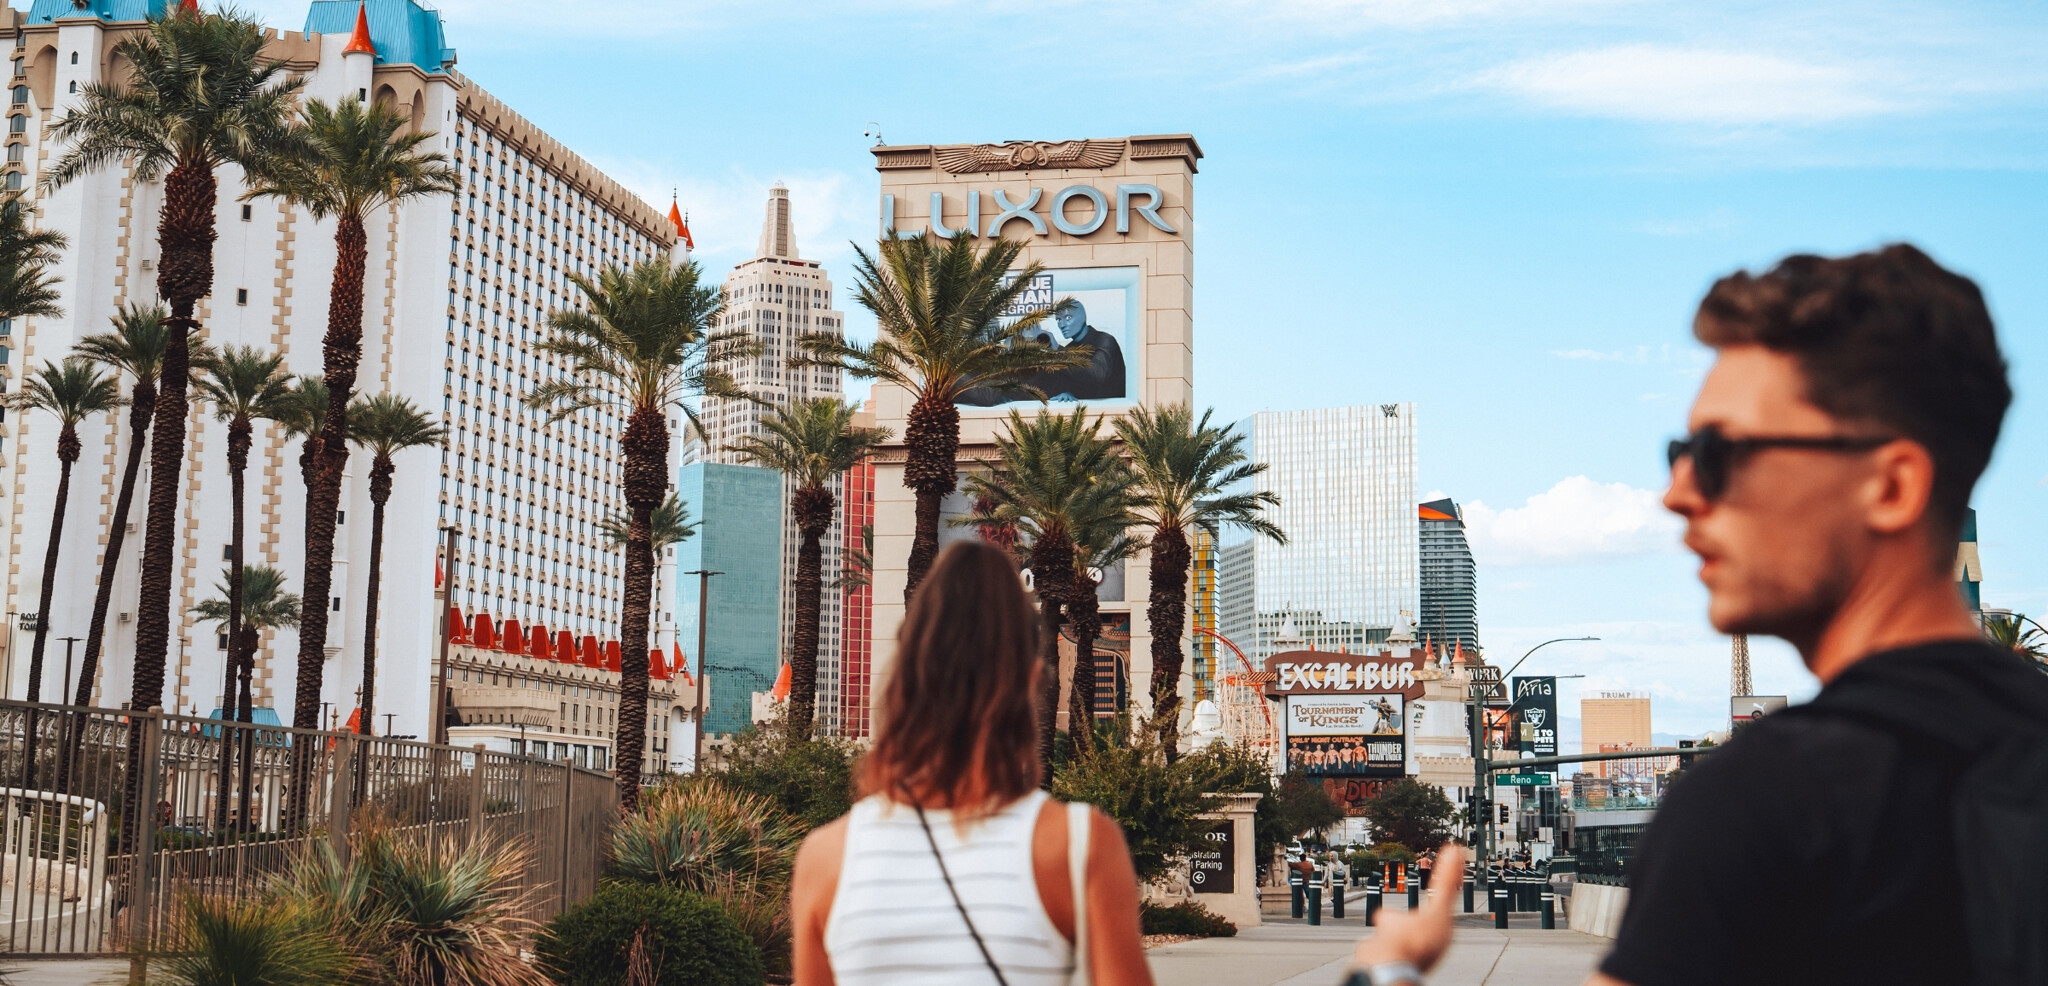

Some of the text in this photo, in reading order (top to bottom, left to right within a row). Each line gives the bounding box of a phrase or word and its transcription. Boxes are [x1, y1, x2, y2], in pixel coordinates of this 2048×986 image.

[882, 184, 1178, 240] LUXOR
[1280, 662, 1415, 691] EXCALIBUR
[1469, 684, 1499, 697] YRK
[1517, 679, 1552, 697] Aria
[1292, 704, 1365, 717] TOURNAMENT
[1310, 715, 1358, 727] KINGS
[1541, 729, 1553, 737] TO
[1367, 743, 1402, 754] THUNDER
[1510, 775, 1531, 784] Reno
[1195, 860, 1223, 871] Parking
